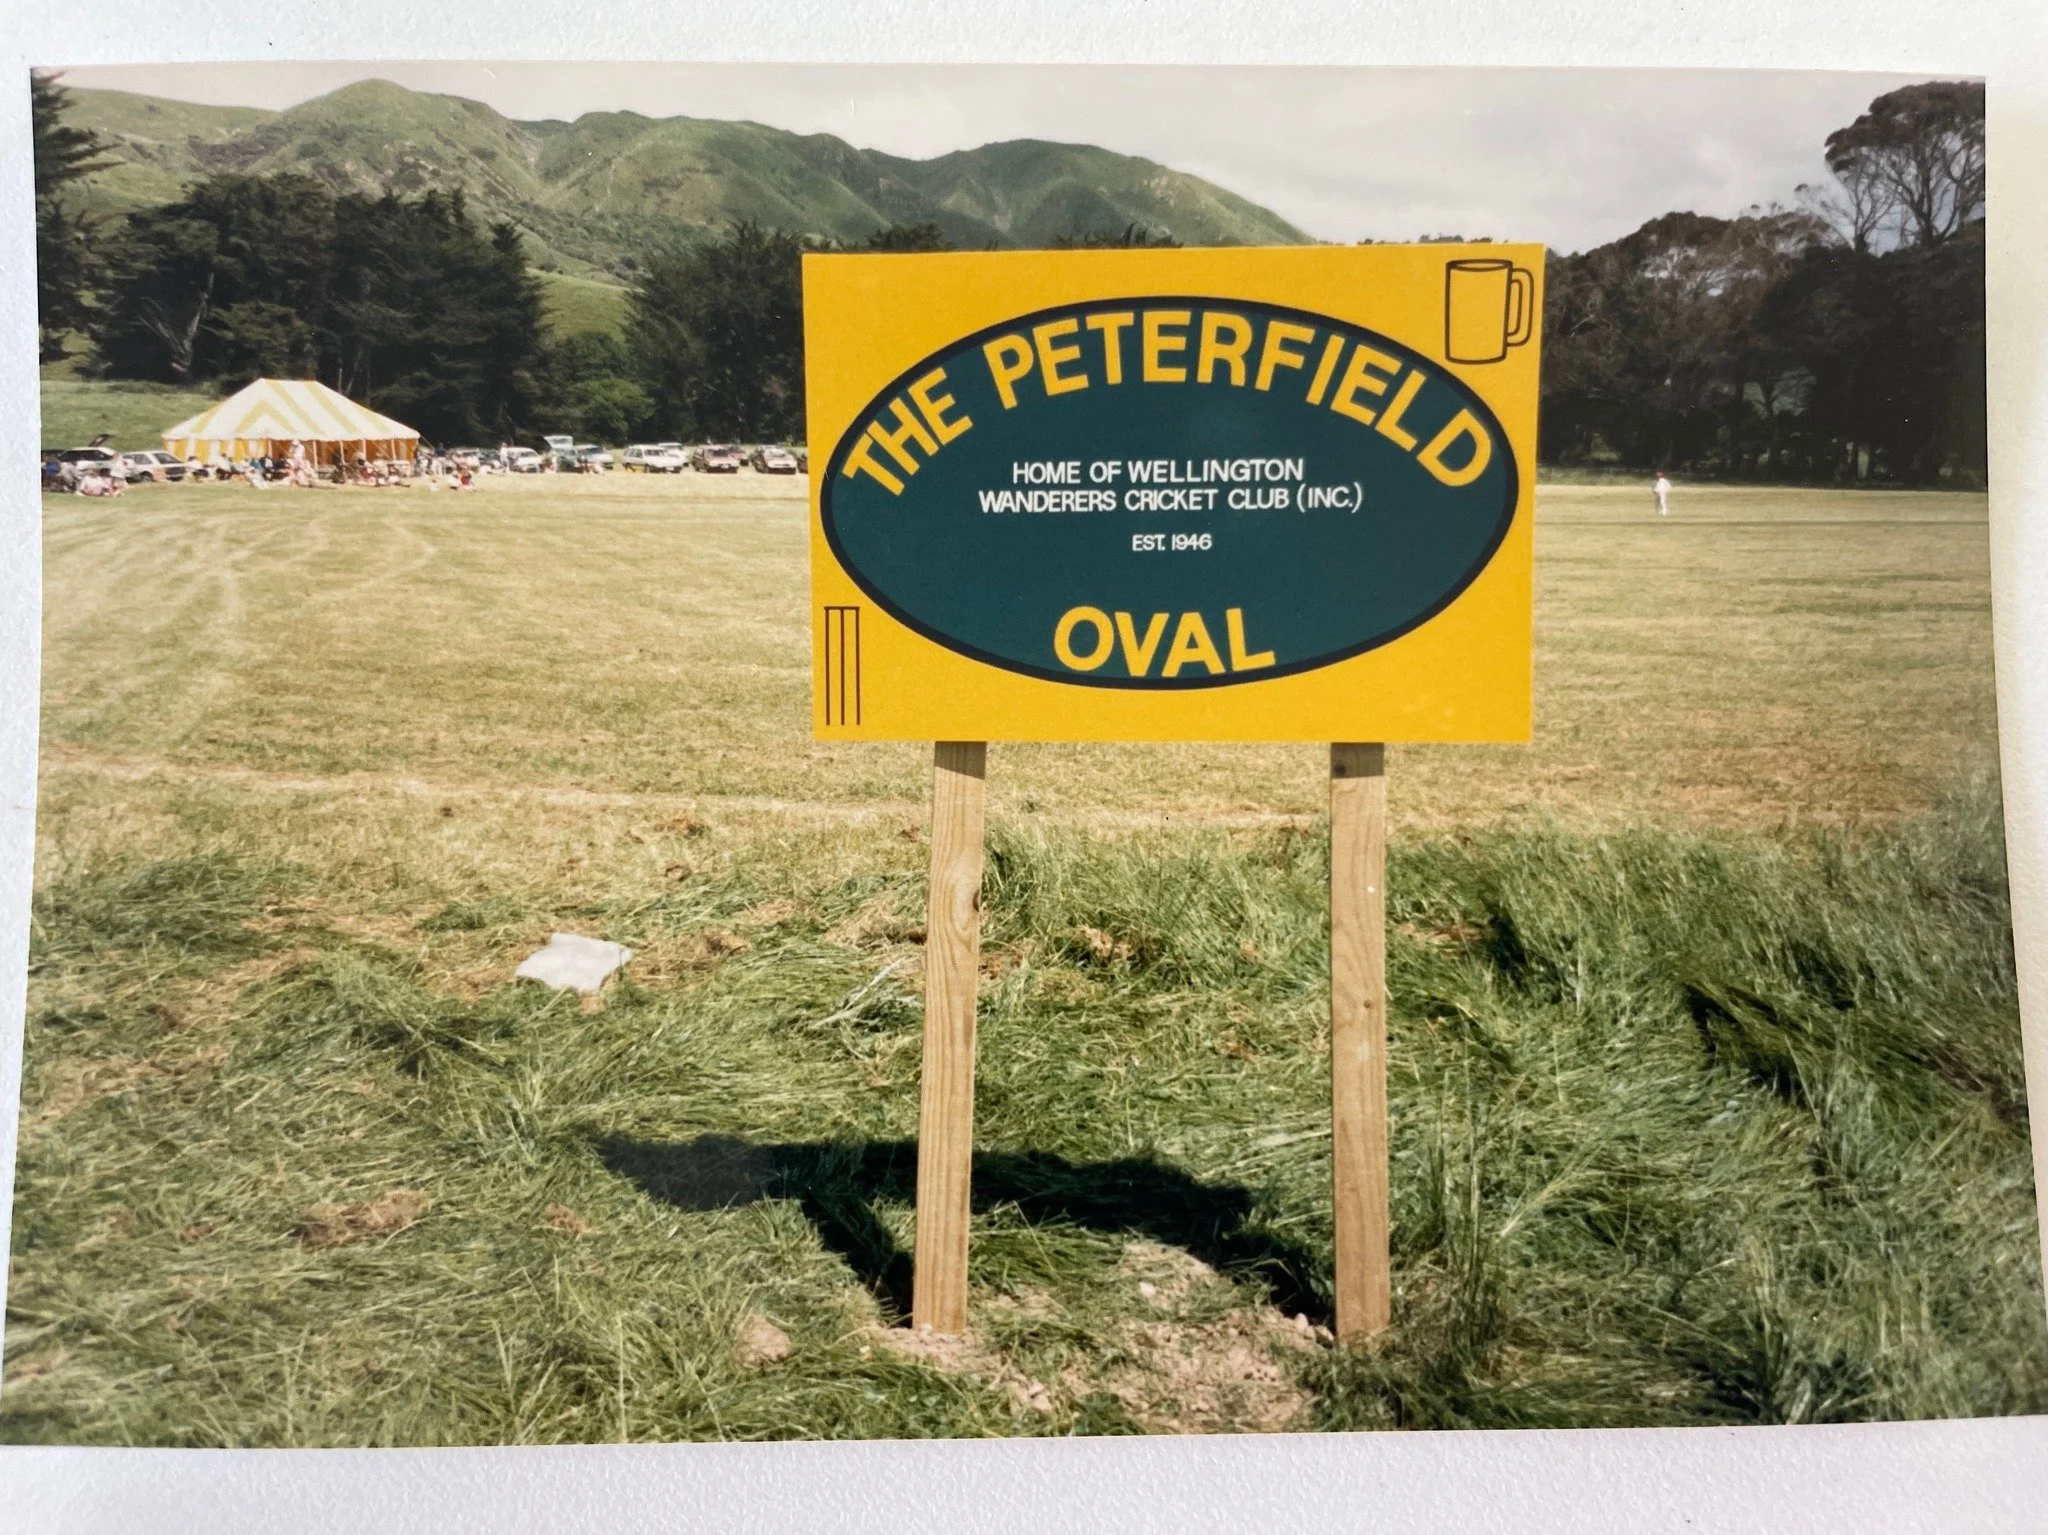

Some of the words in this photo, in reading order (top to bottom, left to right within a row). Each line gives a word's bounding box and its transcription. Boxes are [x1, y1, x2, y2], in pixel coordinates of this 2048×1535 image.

[843, 368, 972, 496] THE
[983, 311, 1492, 486] PETERFIELD
[1013, 461, 1081, 484] HOME
[1090, 461, 1121, 483] OF
[1128, 459, 1305, 485] WELLINGTON
[979, 490, 1116, 513] WANDERERS
[1124, 489, 1218, 511] CRICKET
[1228, 488, 1289, 509] CLUB
[1297, 480, 1362, 513] (INC.)
[1133, 534, 1165, 551] EST.
[1172, 533, 1212, 550] 1946
[1054, 606, 1276, 678] OVAL
